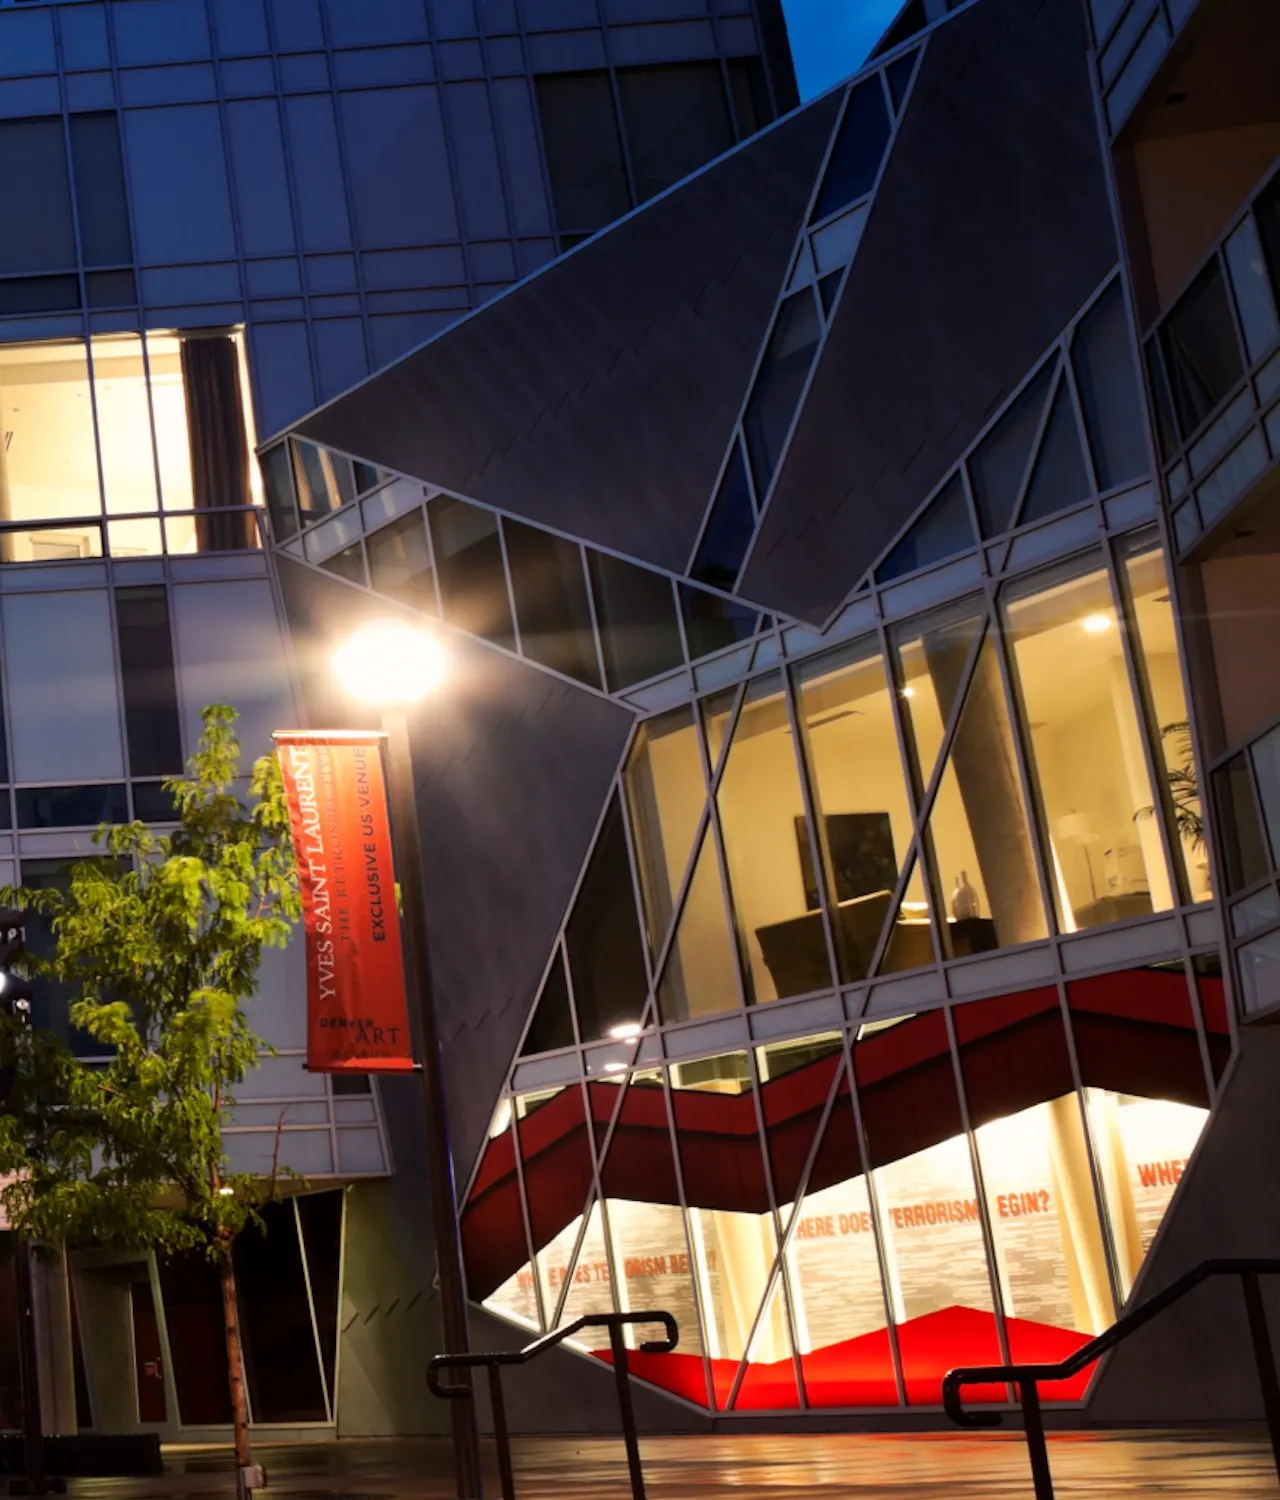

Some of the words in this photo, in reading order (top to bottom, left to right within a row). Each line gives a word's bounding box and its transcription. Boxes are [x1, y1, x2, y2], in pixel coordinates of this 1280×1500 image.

[288, 744, 324, 855] LAURENT
[353, 747, 371, 808] VENUE
[360, 813, 375, 837] US
[307, 858, 332, 934] SAINT
[364, 842, 387, 942] EXCLUSIVE
[339, 906, 351, 943] THE
[316, 940, 336, 1001] YVES
[355, 1025, 401, 1045] ART
[1137, 1160, 1189, 1187] WHE
[794, 1215, 835, 1240] HERE
